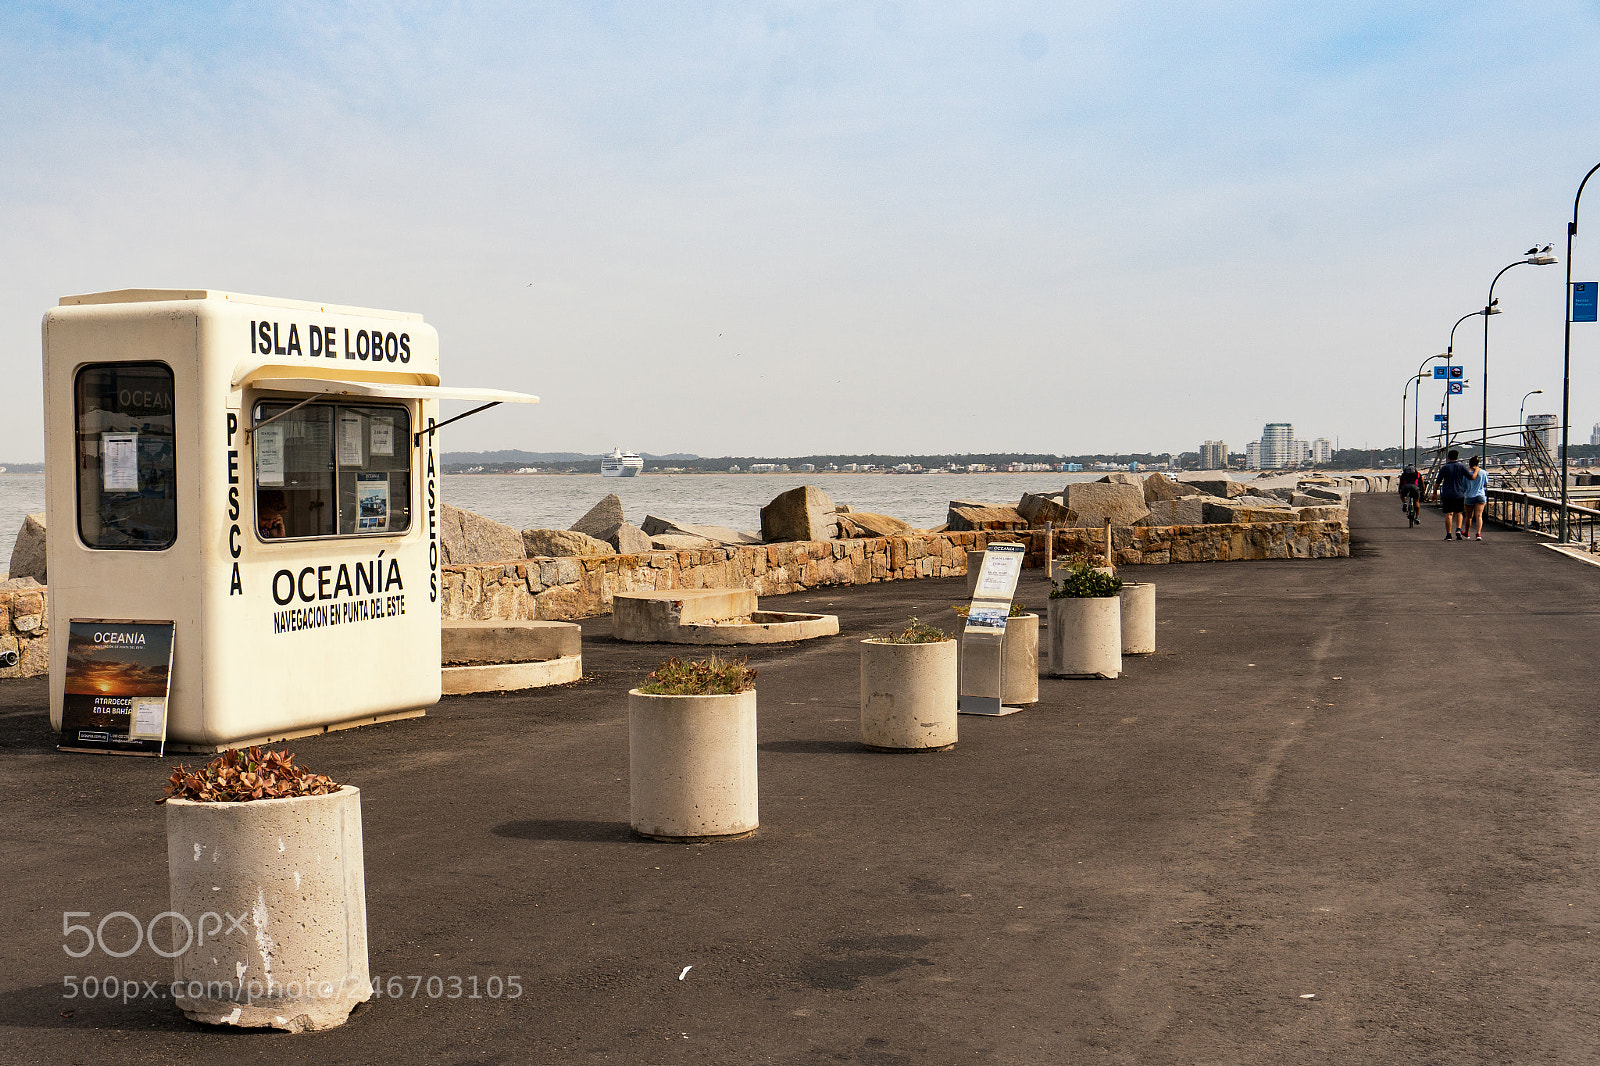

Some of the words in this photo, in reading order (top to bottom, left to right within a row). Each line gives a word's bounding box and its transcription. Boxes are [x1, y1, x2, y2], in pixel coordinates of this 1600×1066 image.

[251, 320, 302, 357] ISLA
[309, 324, 337, 359] DE
[344, 328, 411, 364] LOBOS
[226, 412, 243, 596] PESCA
[427, 417, 438, 603] PASEOS
[272, 549, 404, 606] OCEANÍA
[273, 604, 328, 634] NAVEGACION
[330, 602, 341, 626] EN
[343, 599, 369, 625] PUNTA
[370, 597, 385, 620] DEL
[387, 595, 406, 618] ESTE
[93, 632, 146, 645] OCEANÍA
[93, 706, 102, 714] EN
[112, 706, 133, 715] BAHÍA
[94, 697, 133, 706] ATARDECER
